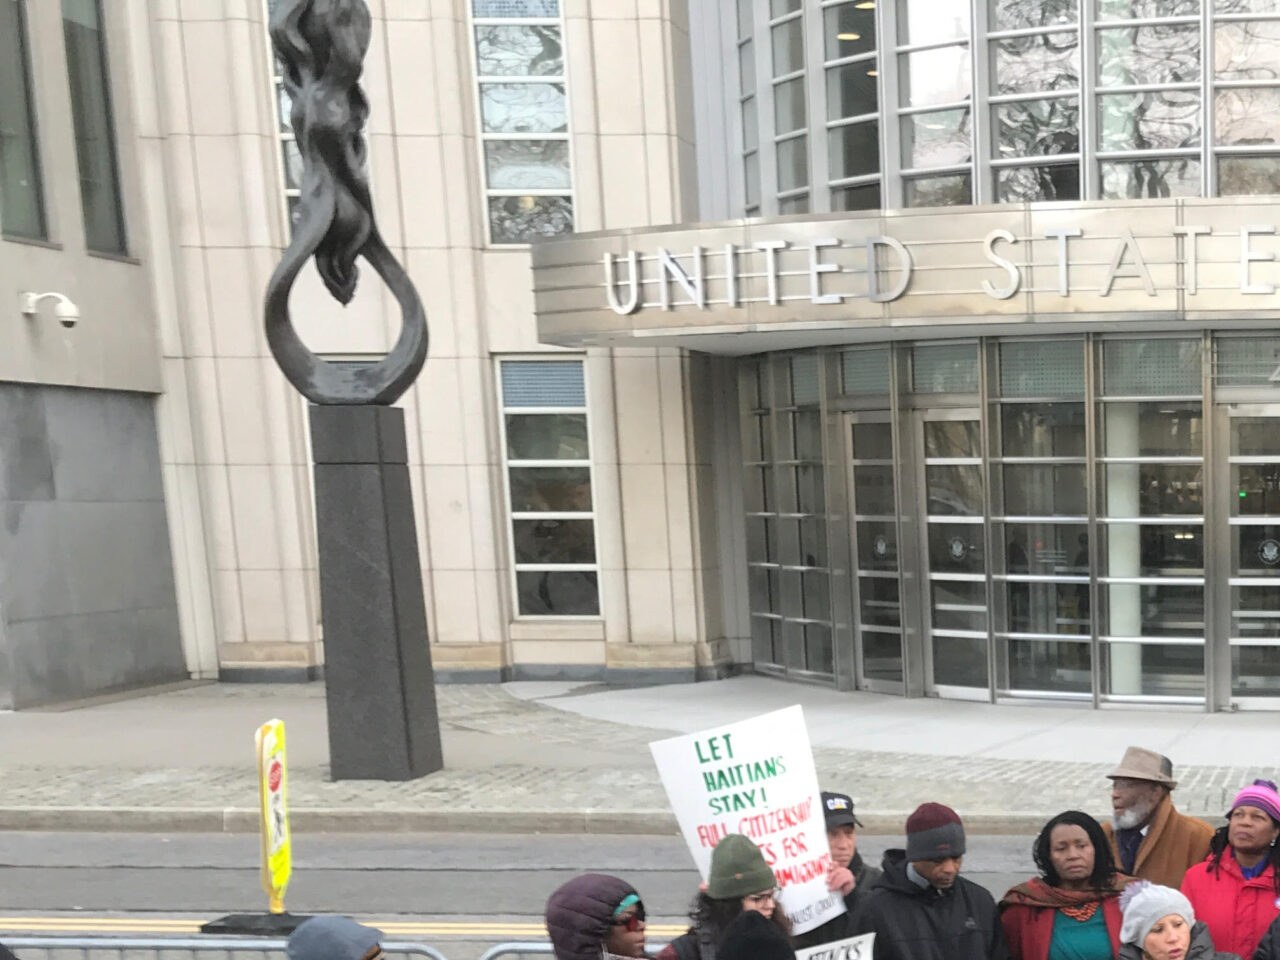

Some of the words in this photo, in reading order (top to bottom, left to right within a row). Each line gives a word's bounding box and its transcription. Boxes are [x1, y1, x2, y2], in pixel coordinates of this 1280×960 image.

[603, 235, 913, 315] UNITED
[694, 733, 734, 764] LET
[702, 755, 787, 793] HAITIANS
[708, 787, 768, 816] STAY!
